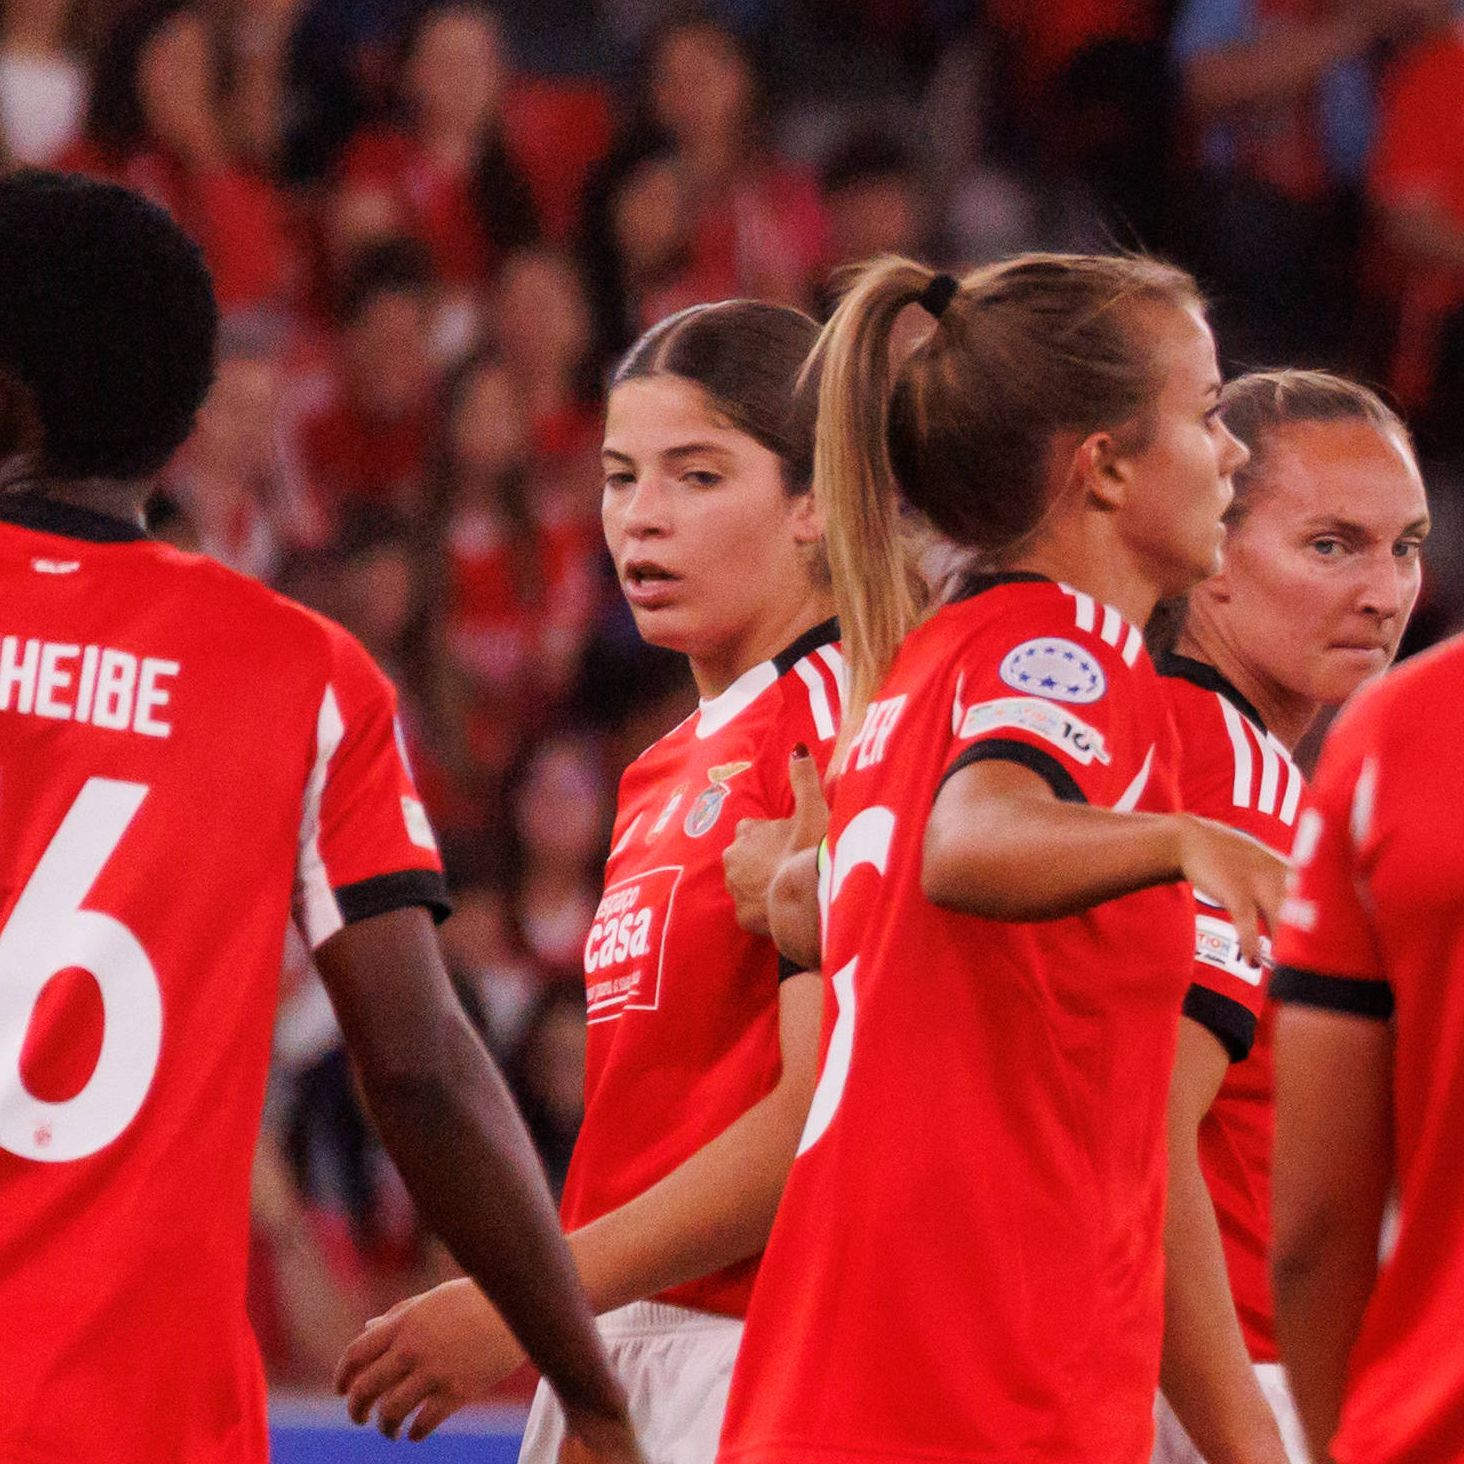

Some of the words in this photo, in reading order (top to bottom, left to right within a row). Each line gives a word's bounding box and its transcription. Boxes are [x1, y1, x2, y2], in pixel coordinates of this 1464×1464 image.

[0, 635, 180, 738] HEIBE
[0, 777, 164, 1162] 6
[584, 907, 652, 974] casa
